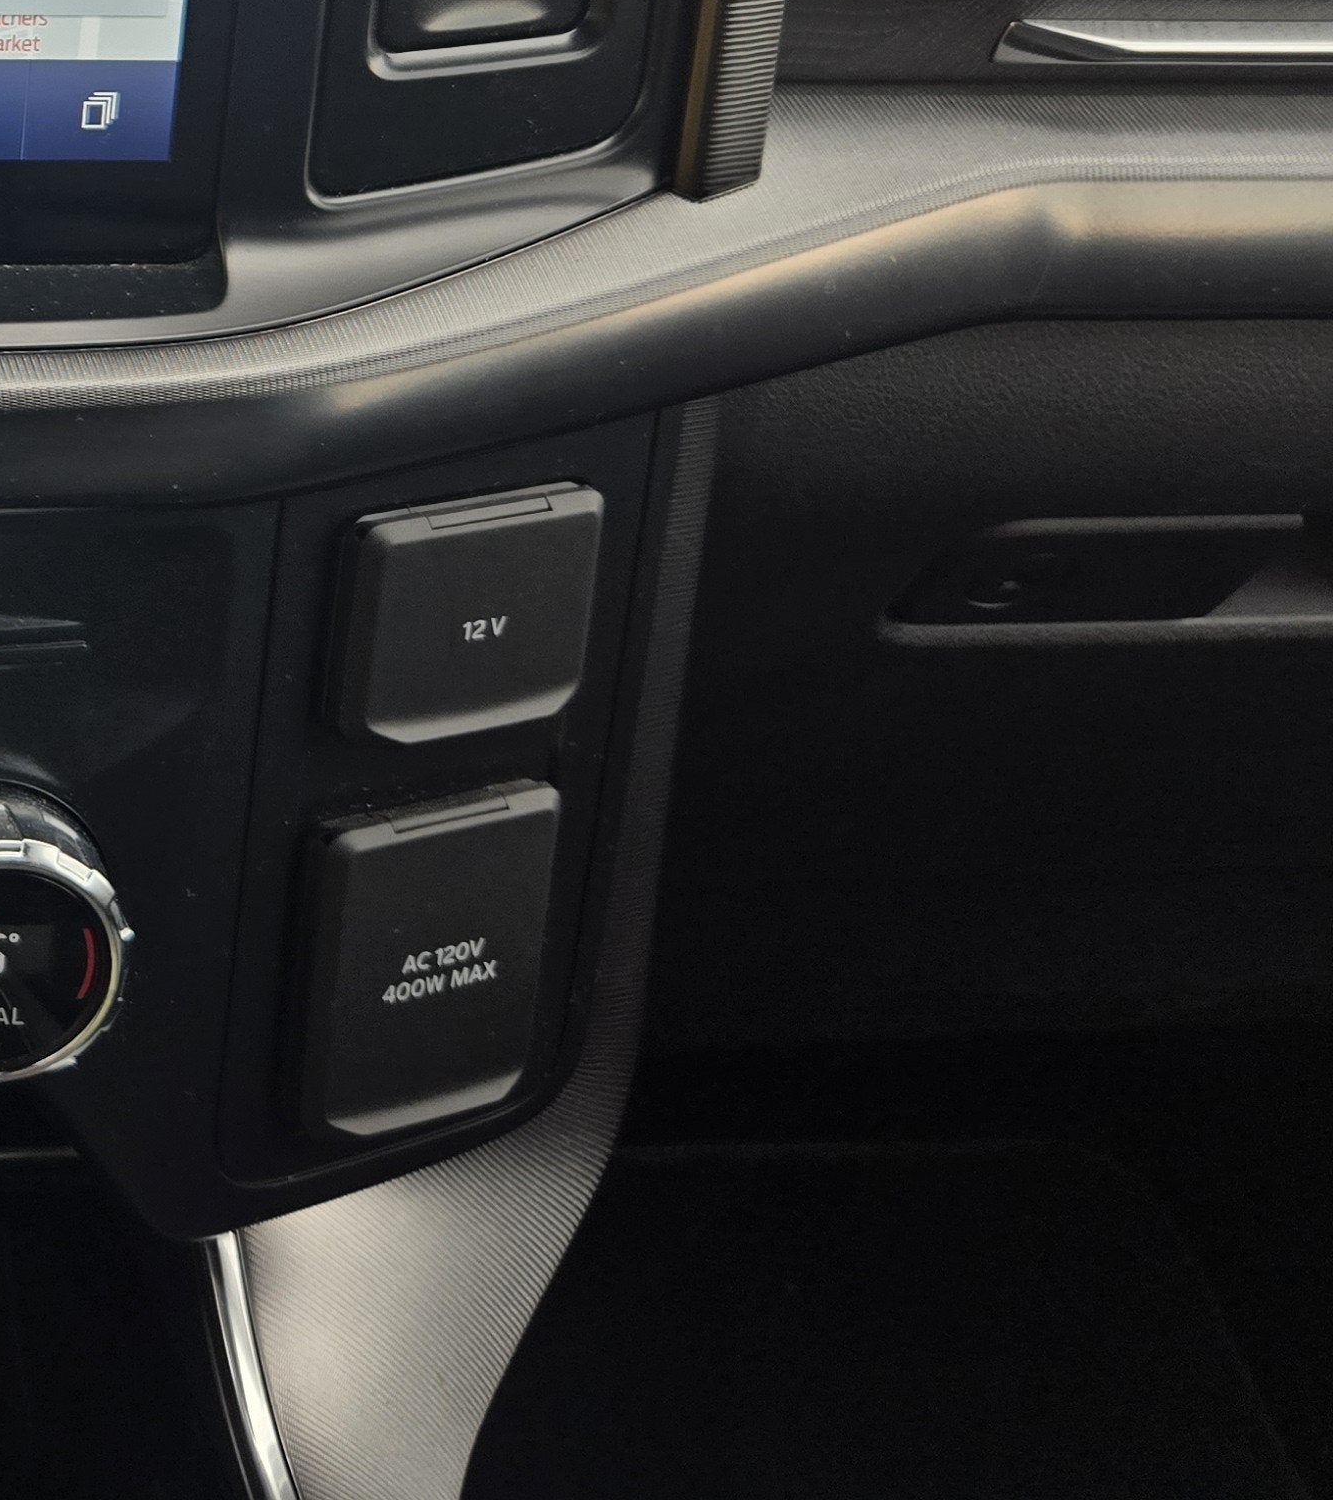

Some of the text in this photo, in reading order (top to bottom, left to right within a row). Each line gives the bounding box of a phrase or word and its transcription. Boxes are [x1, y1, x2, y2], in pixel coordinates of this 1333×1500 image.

[462, 616, 509, 641] 12 V
[401, 937, 487, 975] AC 120V
[382, 959, 498, 1005] 400W MAX
